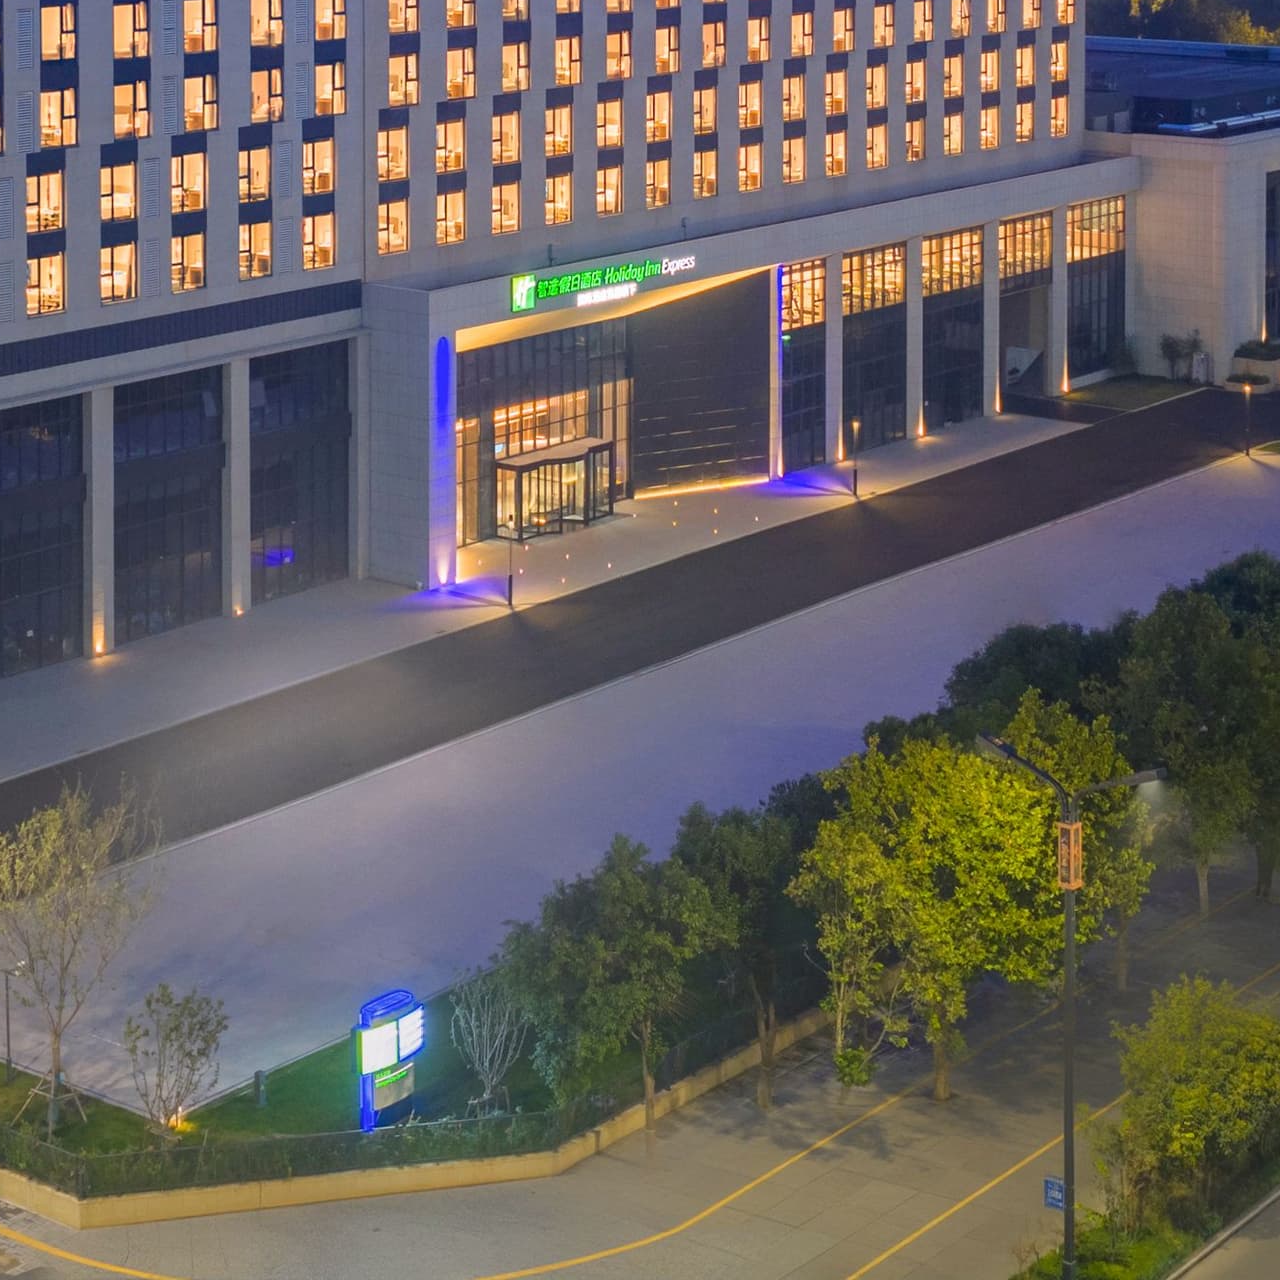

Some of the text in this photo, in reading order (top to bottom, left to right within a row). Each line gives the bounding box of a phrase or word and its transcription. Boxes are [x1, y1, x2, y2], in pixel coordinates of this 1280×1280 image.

[604, 255, 696, 284] Holiday Inn Express
